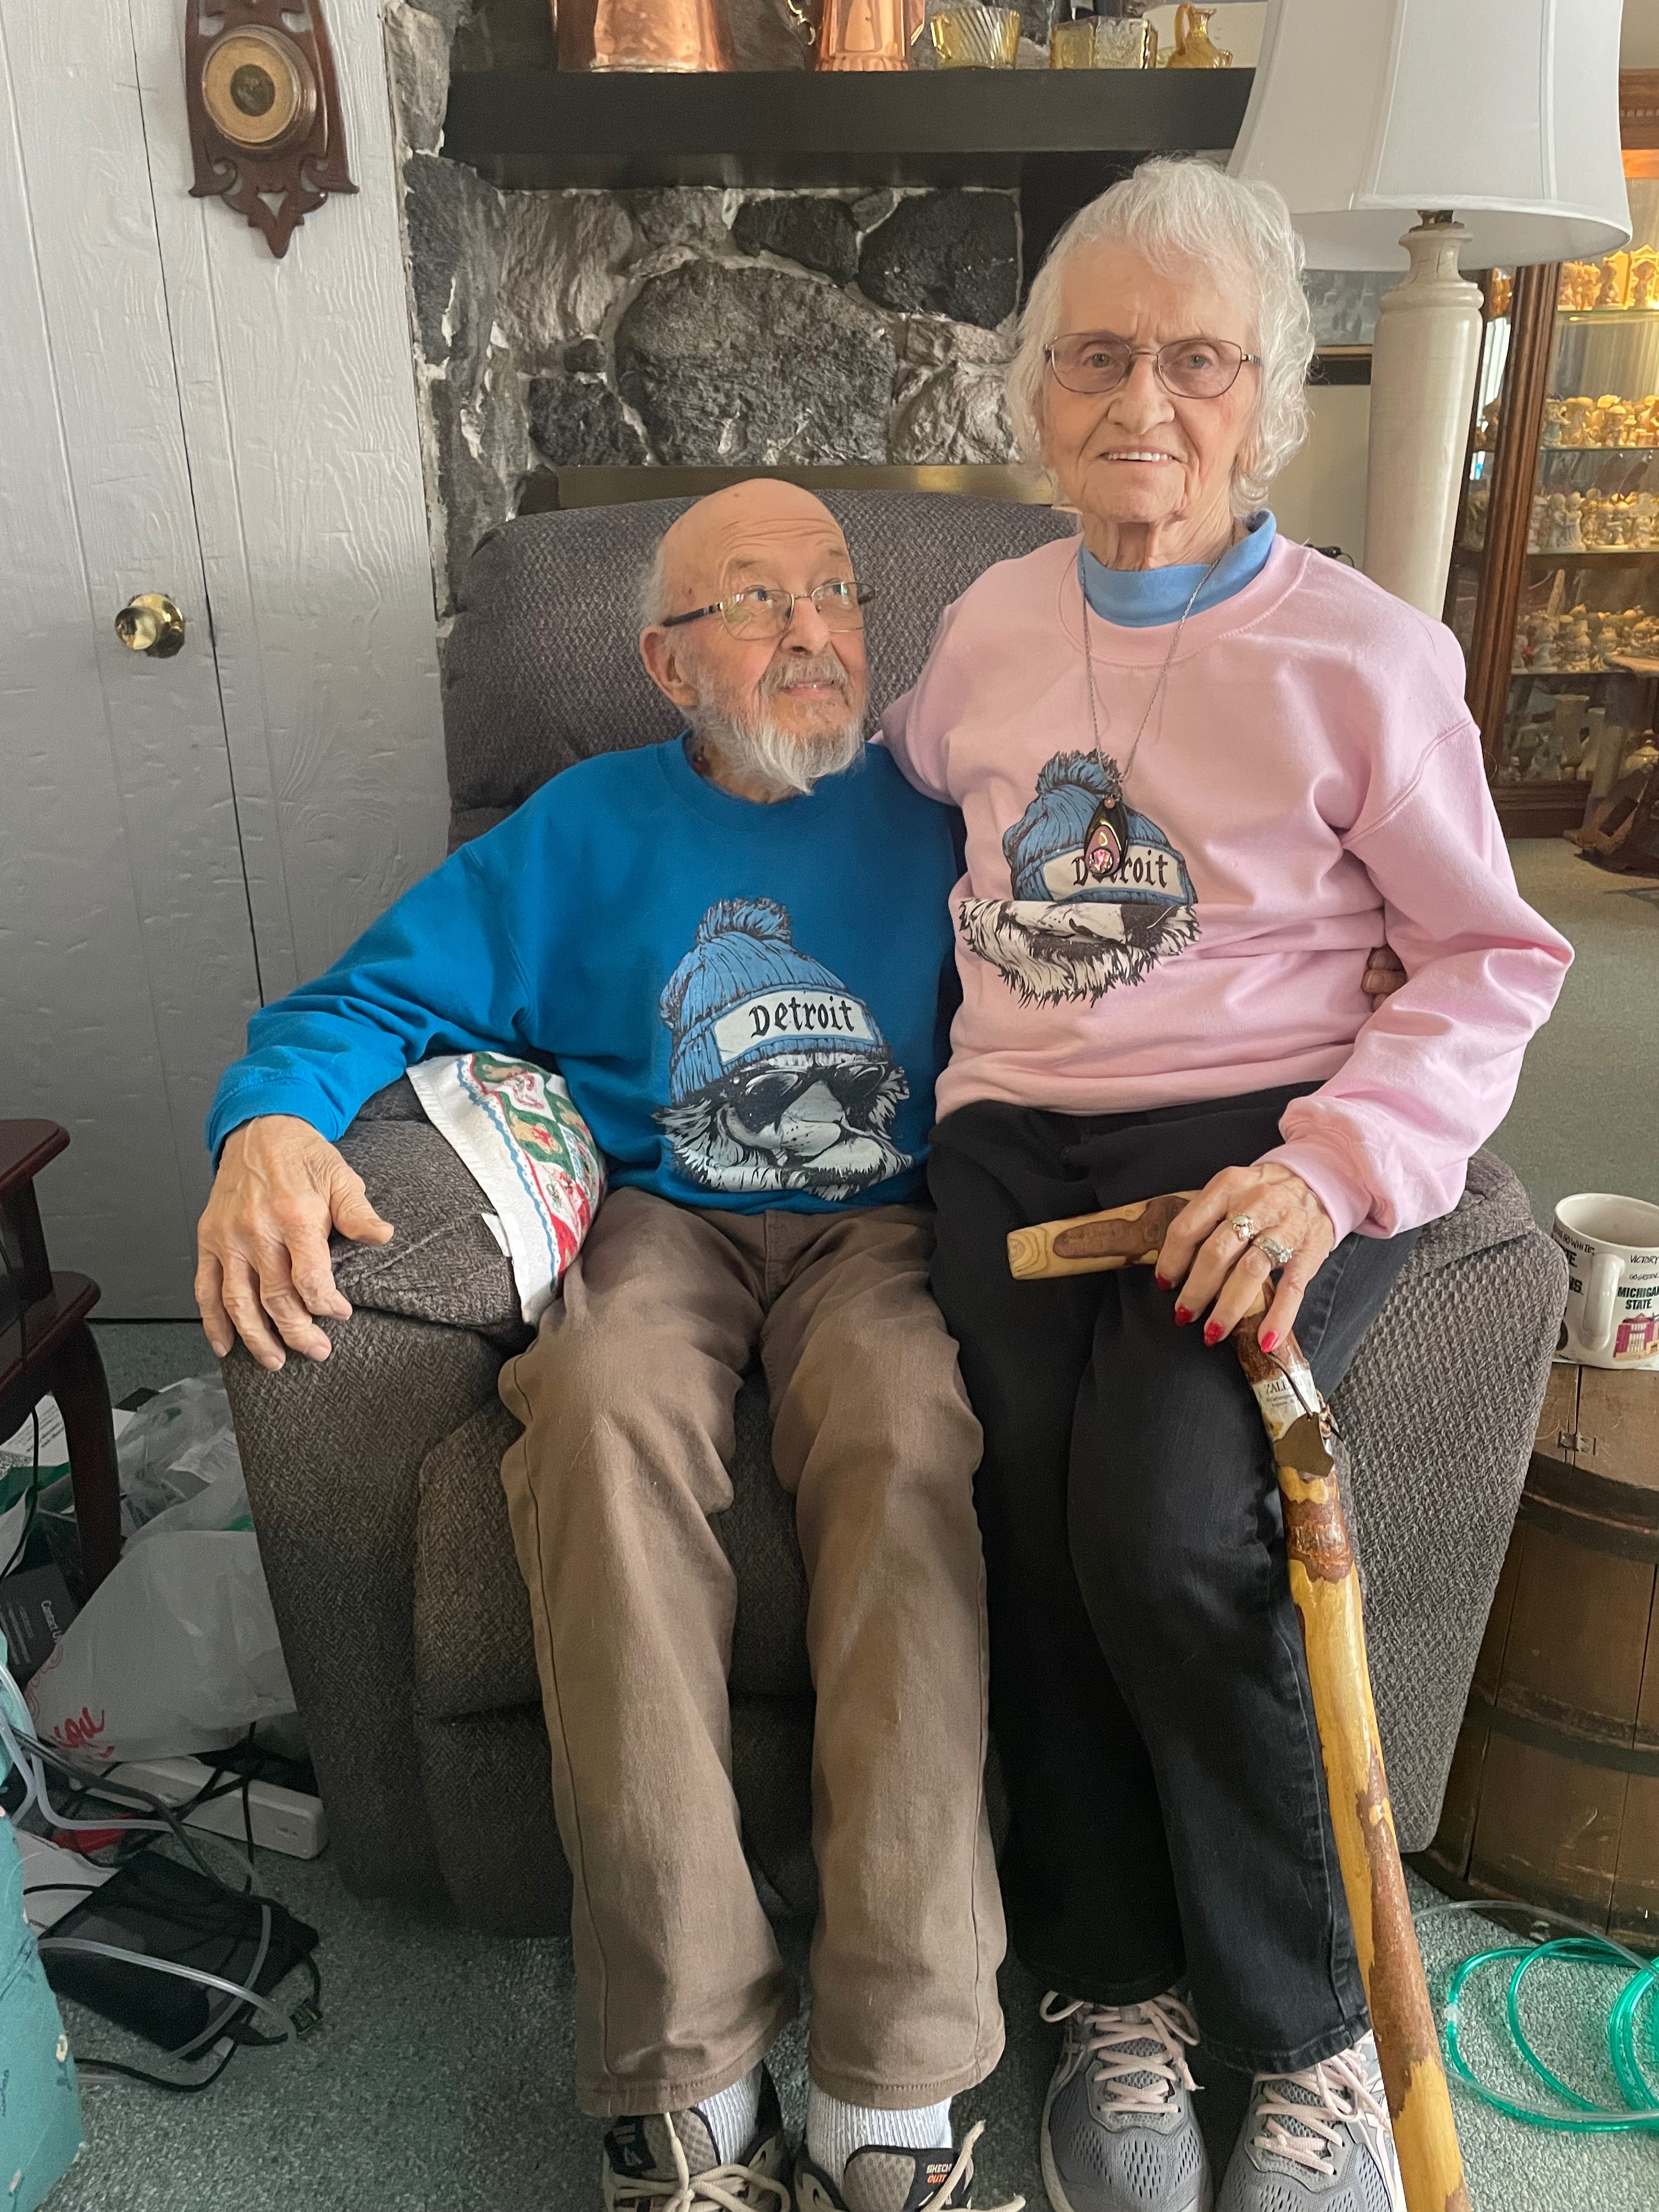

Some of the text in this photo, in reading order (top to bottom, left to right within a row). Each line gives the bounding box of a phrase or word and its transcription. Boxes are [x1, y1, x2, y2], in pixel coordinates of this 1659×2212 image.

[1071, 850, 1168, 888] Droit
[748, 996, 855, 1039] Detroit
[1630, 1255, 1659, 1265] VICTORY
[1626, 1299, 1652, 1310] STATE
